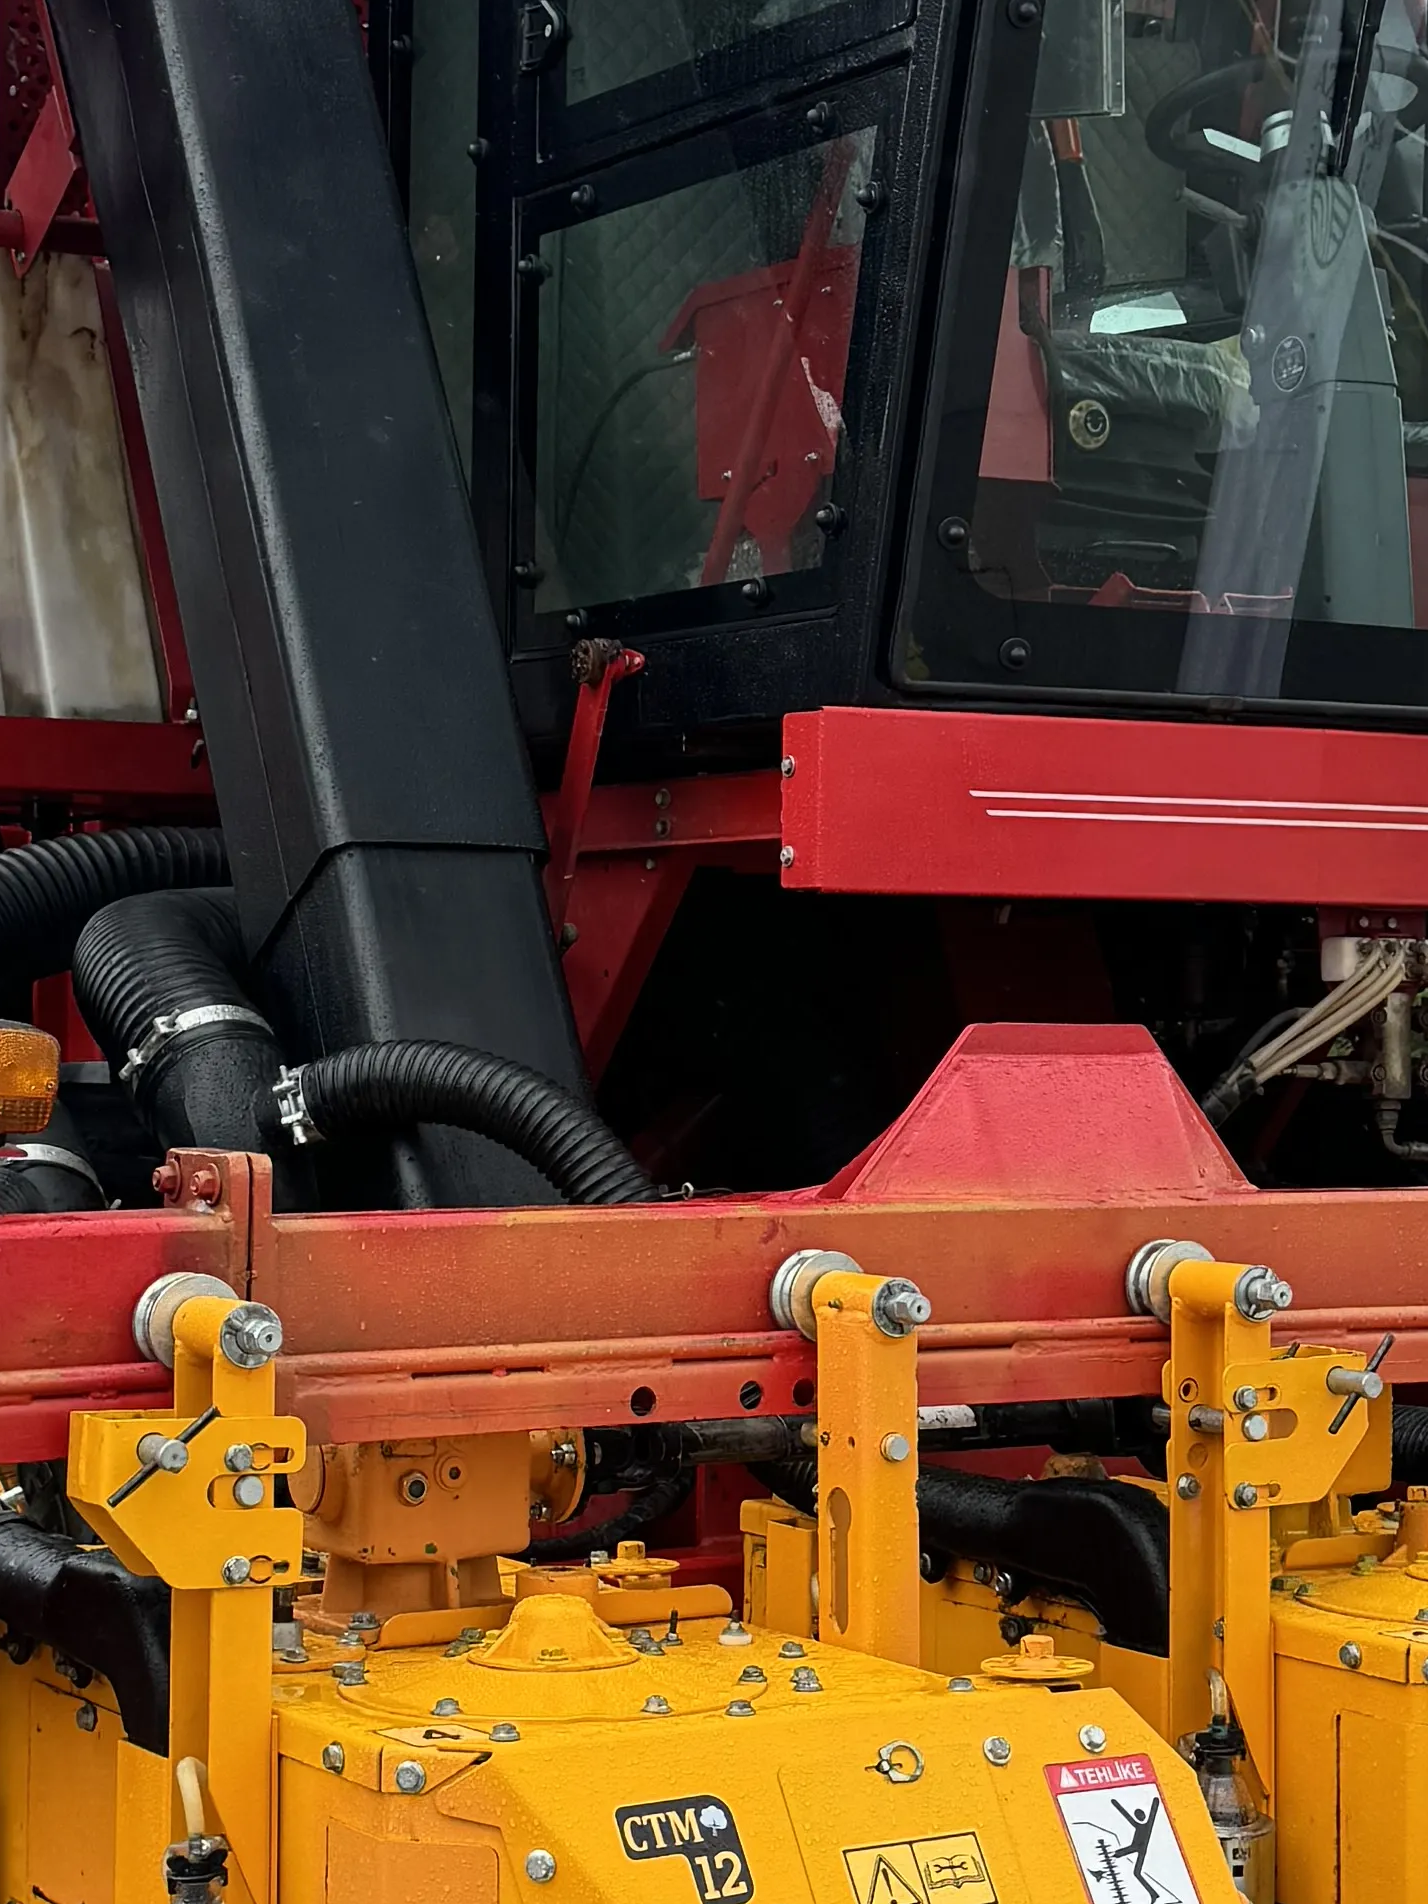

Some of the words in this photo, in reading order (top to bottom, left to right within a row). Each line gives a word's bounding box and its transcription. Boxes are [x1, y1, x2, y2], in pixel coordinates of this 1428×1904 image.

[1073, 1761, 1146, 1785] TEHLİKE
[623, 1808, 704, 1852] CTM
[695, 1851, 748, 1900] 12
